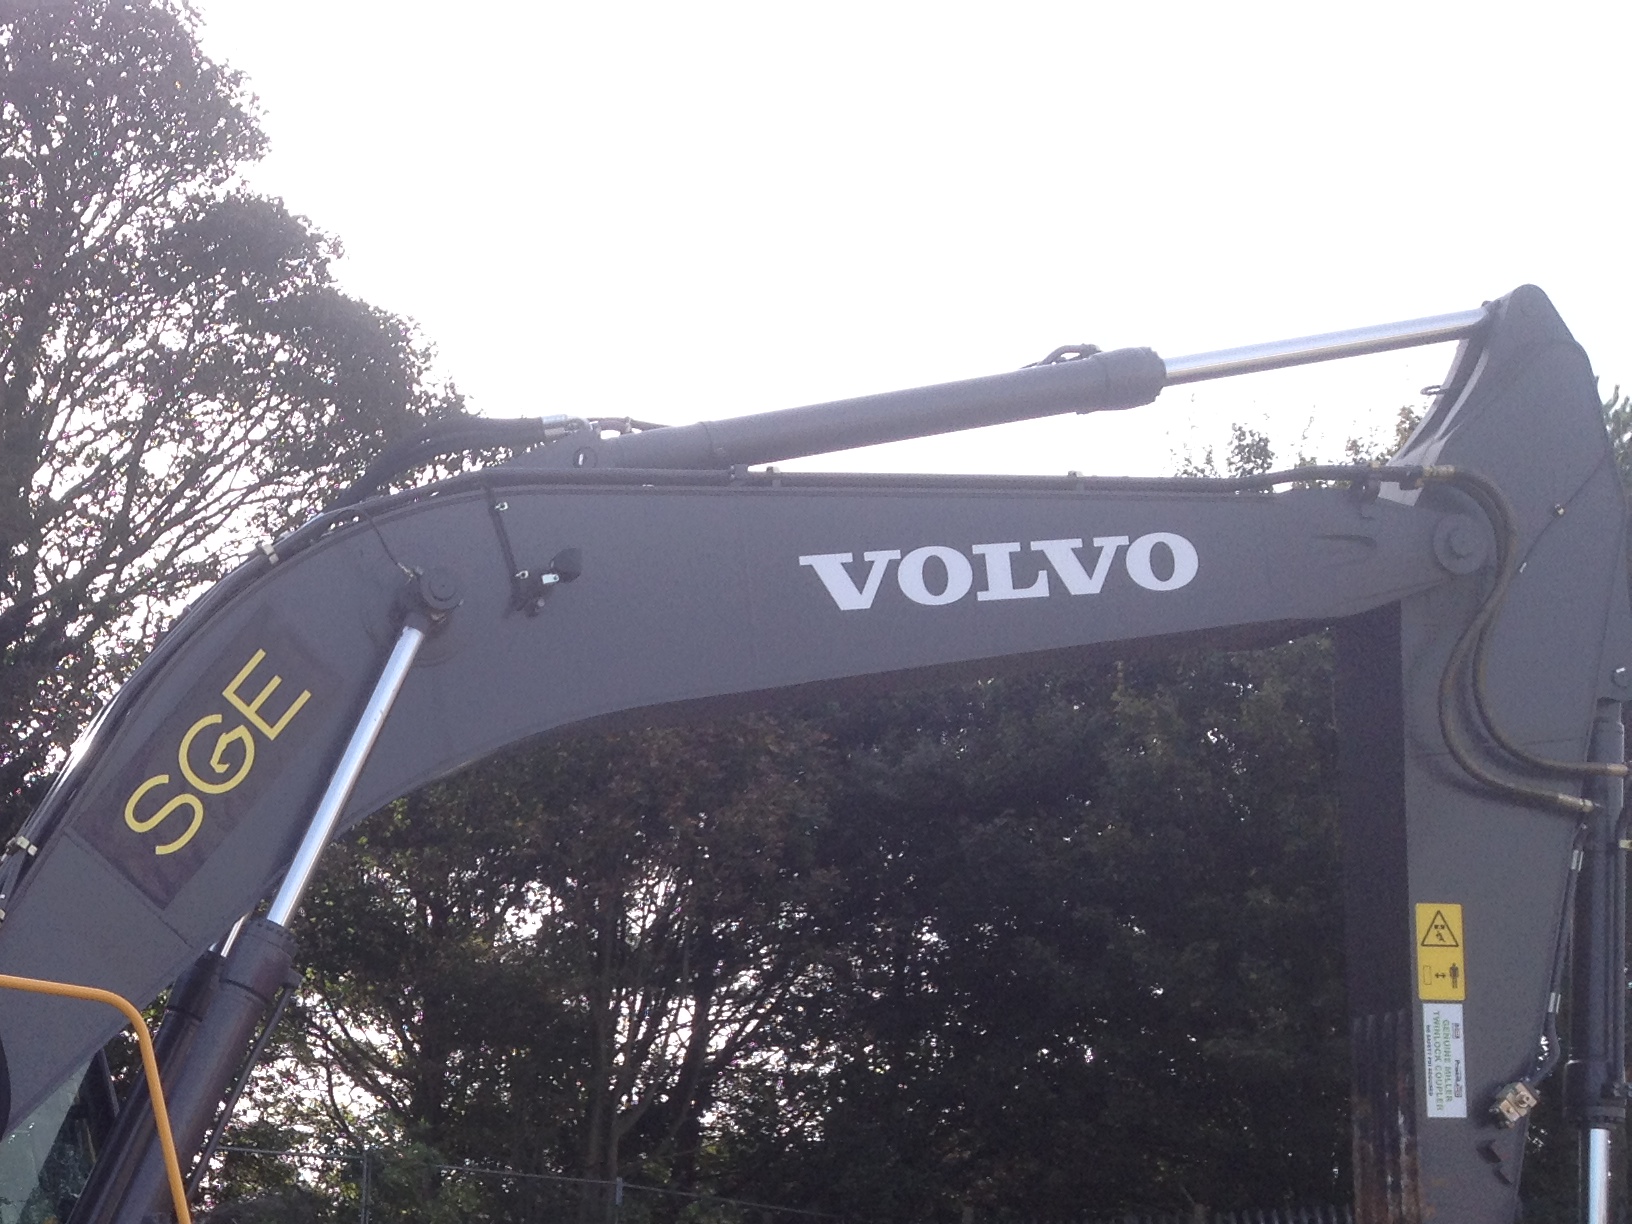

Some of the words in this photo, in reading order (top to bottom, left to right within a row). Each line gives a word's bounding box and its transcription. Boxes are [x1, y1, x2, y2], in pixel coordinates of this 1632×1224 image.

[799, 532, 1199, 610] VOLVO
[124, 648, 312, 855] SGE
[1433, 1011, 1442, 1062] TWINLOCK
[1442, 1019, 1452, 1063] GENUINE
[1435, 1065, 1444, 1111] COUPLER
[1444, 1066, 1453, 1102] MILLER
